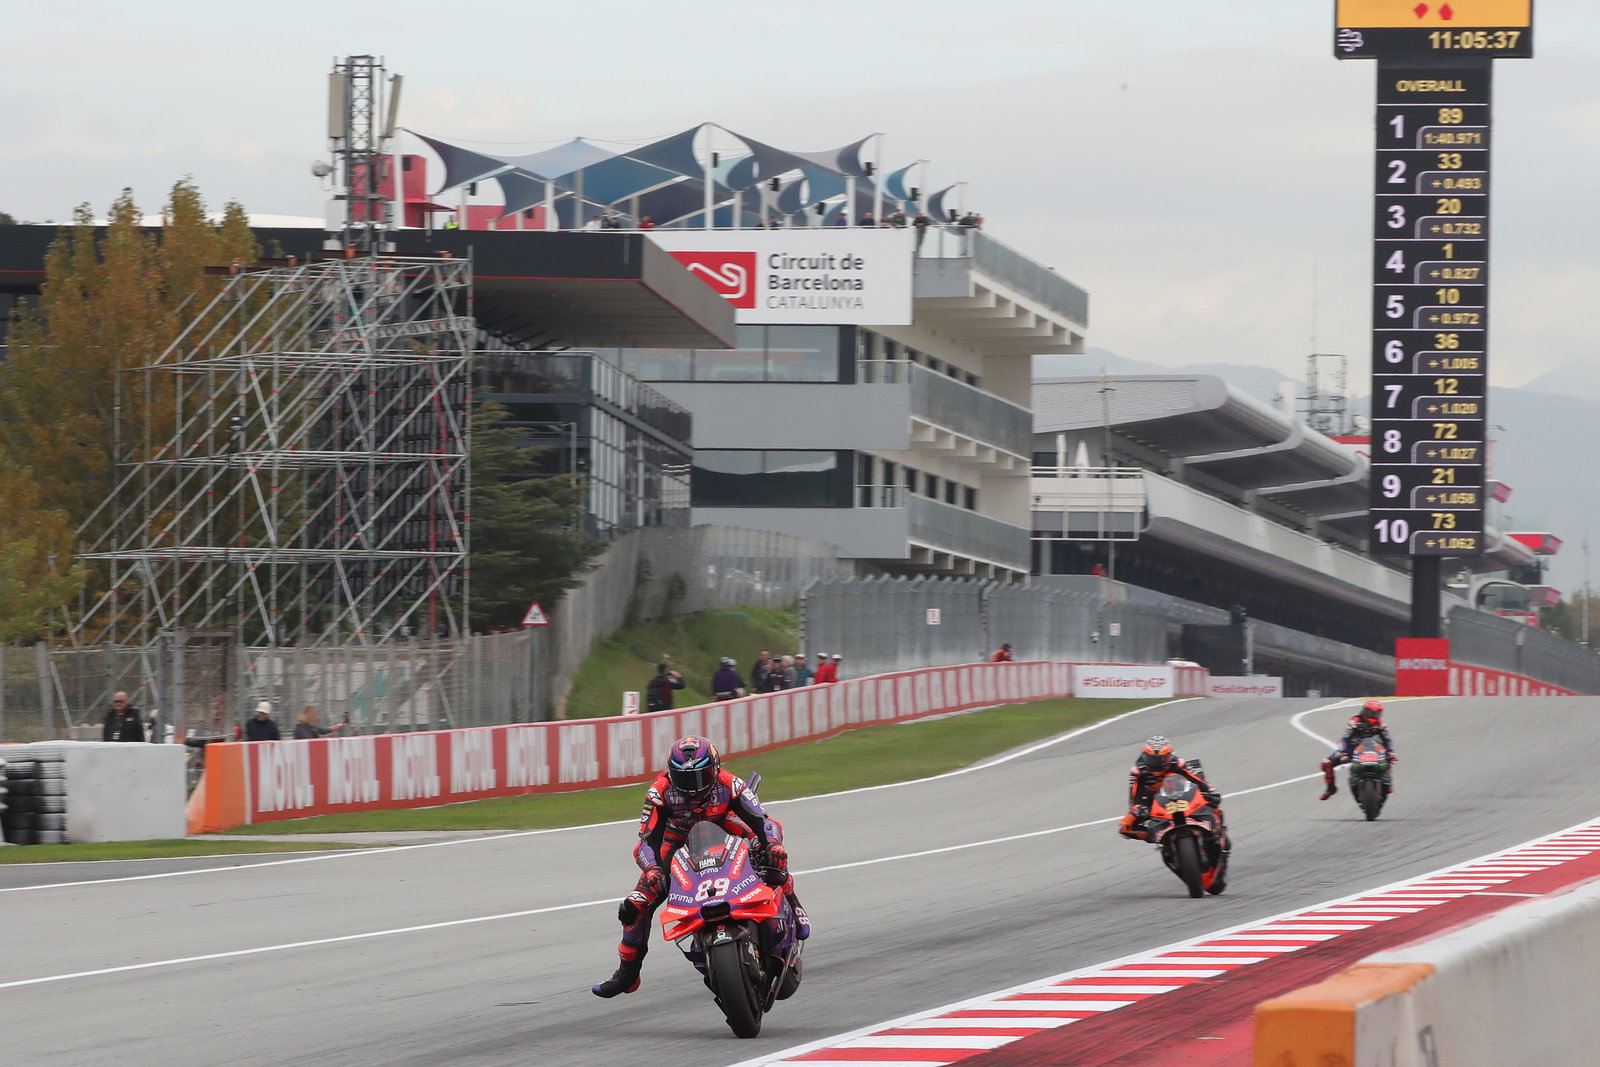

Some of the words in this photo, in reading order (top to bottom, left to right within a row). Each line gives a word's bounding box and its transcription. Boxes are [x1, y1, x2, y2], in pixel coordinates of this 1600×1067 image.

[1429, 31, 1521, 49] 11:05:37
[1395, 80, 1466, 92] OVERALL
[1438, 108, 1463, 124] 89
[1389, 115, 1404, 138] 1
[1437, 153, 1462, 169] 33
[1388, 160, 1407, 184] 2
[1436, 198, 1462, 214] 20
[1387, 205, 1406, 229] 3
[1442, 243, 1454, 258] 1
[767, 252, 835, 271] Circuit
[841, 252, 865, 271] de
[1385, 250, 1406, 273] 4
[768, 274, 864, 291] Barcelona
[766, 295, 865, 310] CATALUNYA
[1436, 288, 1460, 304] 10
[1386, 295, 1405, 318] 5
[1434, 334, 1460, 350] 36
[1384, 340, 1404, 364] 6
[1434, 378, 1458, 394] 12
[1384, 384, 1403, 408] 7
[1432, 423, 1458, 439] 72
[1383, 430, 1402, 453] 8
[1432, 468, 1455, 484] 21
[1382, 474, 1402, 498] 9
[1431, 513, 1456, 529] 73
[1374, 519, 1409, 544] 10
[1082, 675, 1167, 691] #SolidarityGP
[698, 858, 716, 870] FIAMM
[732, 848, 748, 876] PRAMAC
[700, 866, 719, 878] prima
[694, 877, 730, 902] 89
[732, 874, 757, 896] prima
[669, 892, 694, 904] prima
[740, 887, 762, 904] MOTUL
[666, 906, 690, 916] MOTUL
